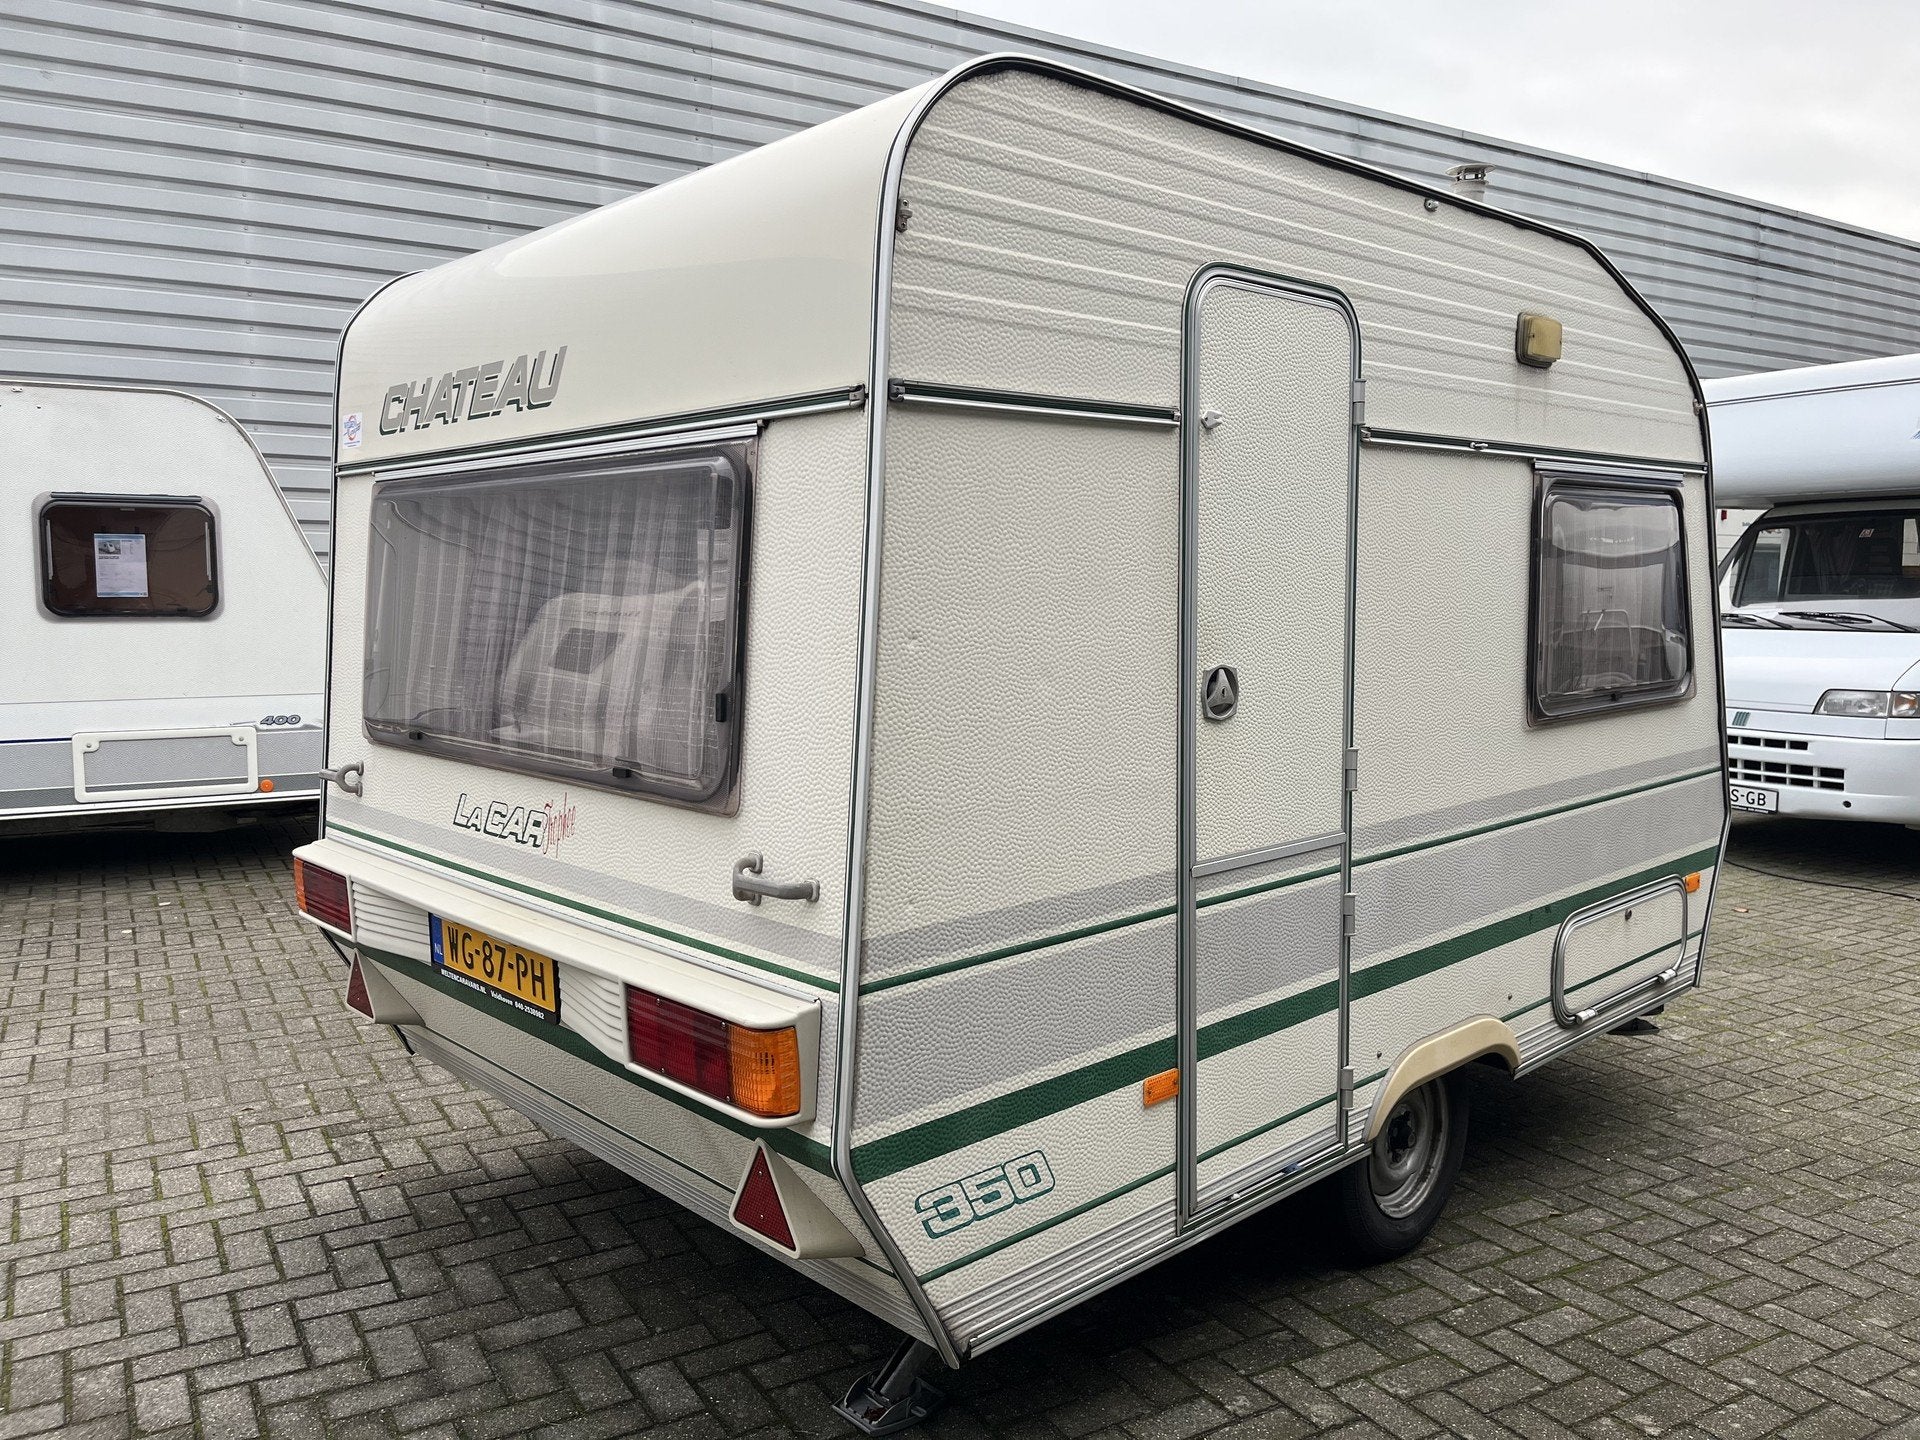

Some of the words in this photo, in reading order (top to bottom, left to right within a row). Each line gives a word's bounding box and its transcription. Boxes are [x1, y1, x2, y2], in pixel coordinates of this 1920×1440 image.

[379, 345, 568, 436] CHATEAU
[260, 714, 301, 726] 400
[434, 943, 443, 956] NL
[448, 925, 547, 1001] WG-87-PH
[914, 1150, 1056, 1240] 350
